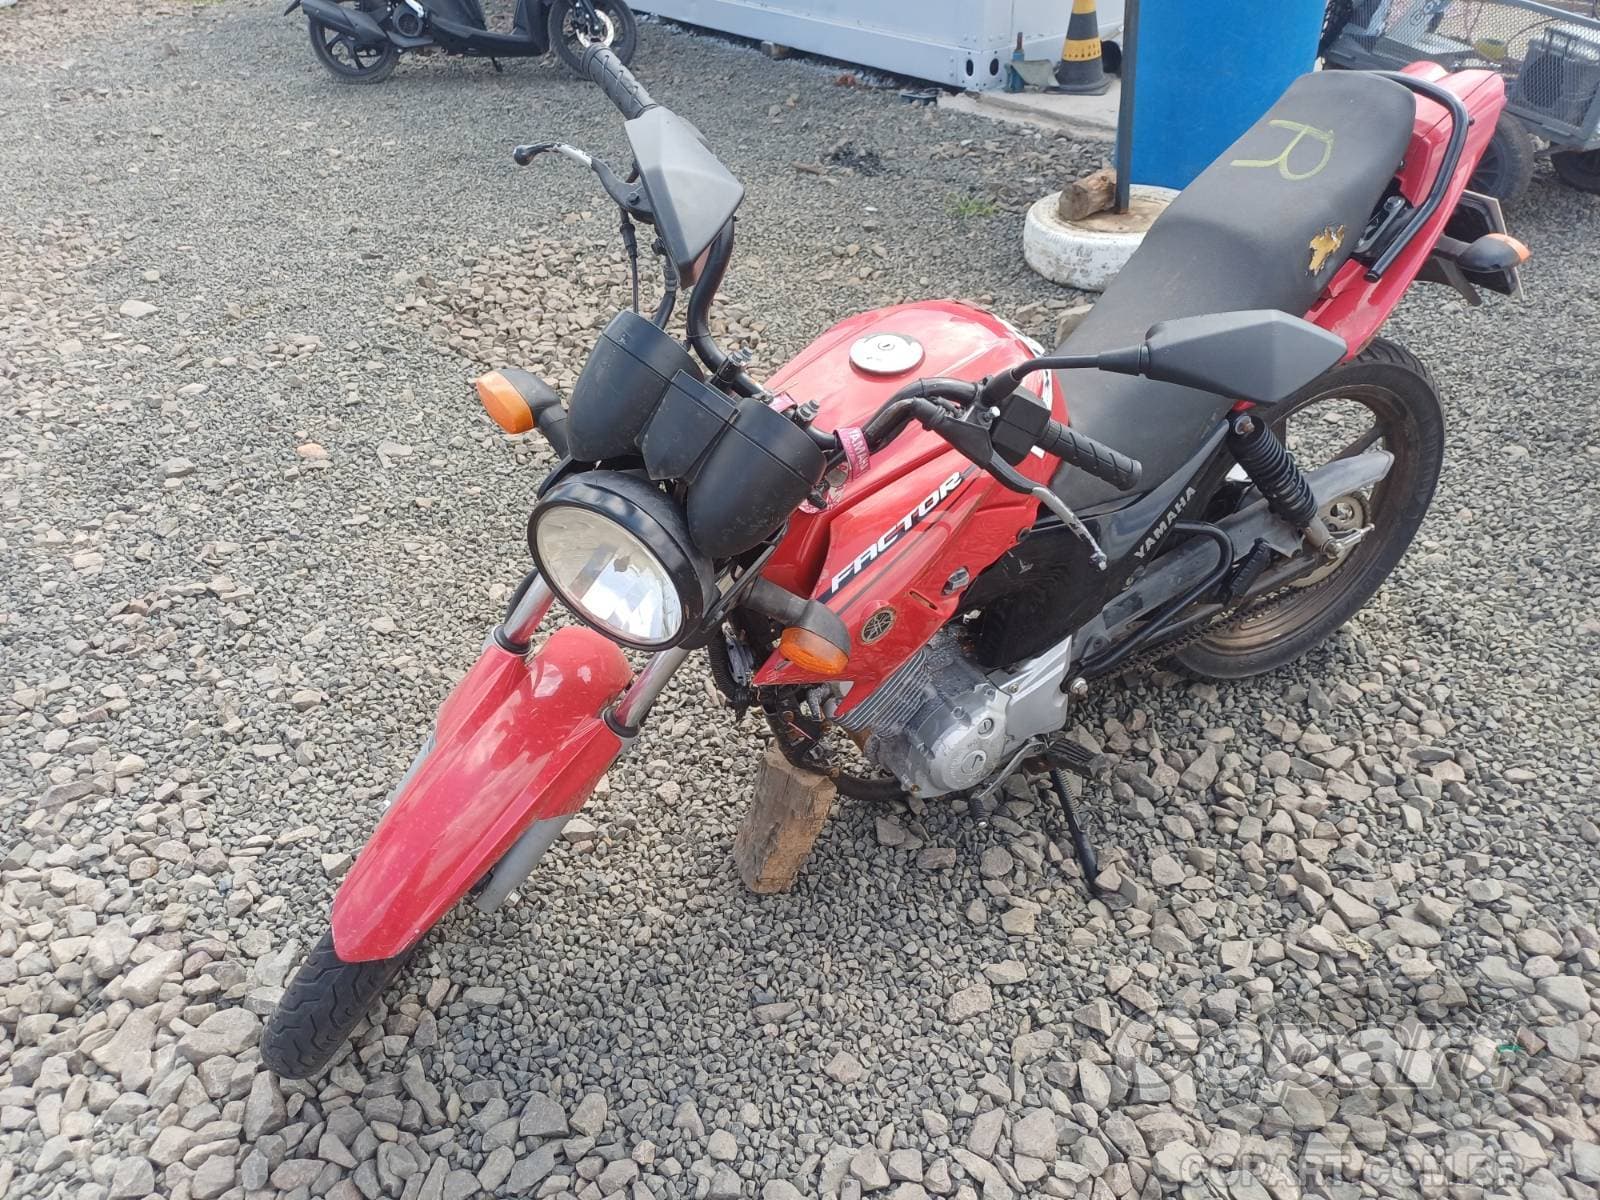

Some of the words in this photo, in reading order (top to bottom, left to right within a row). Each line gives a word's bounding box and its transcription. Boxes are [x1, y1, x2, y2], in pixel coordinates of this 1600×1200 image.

[1230, 119, 1334, 180] R
[831, 472, 962, 593] FACTOR
[1134, 486, 1196, 559] YAMAHA
